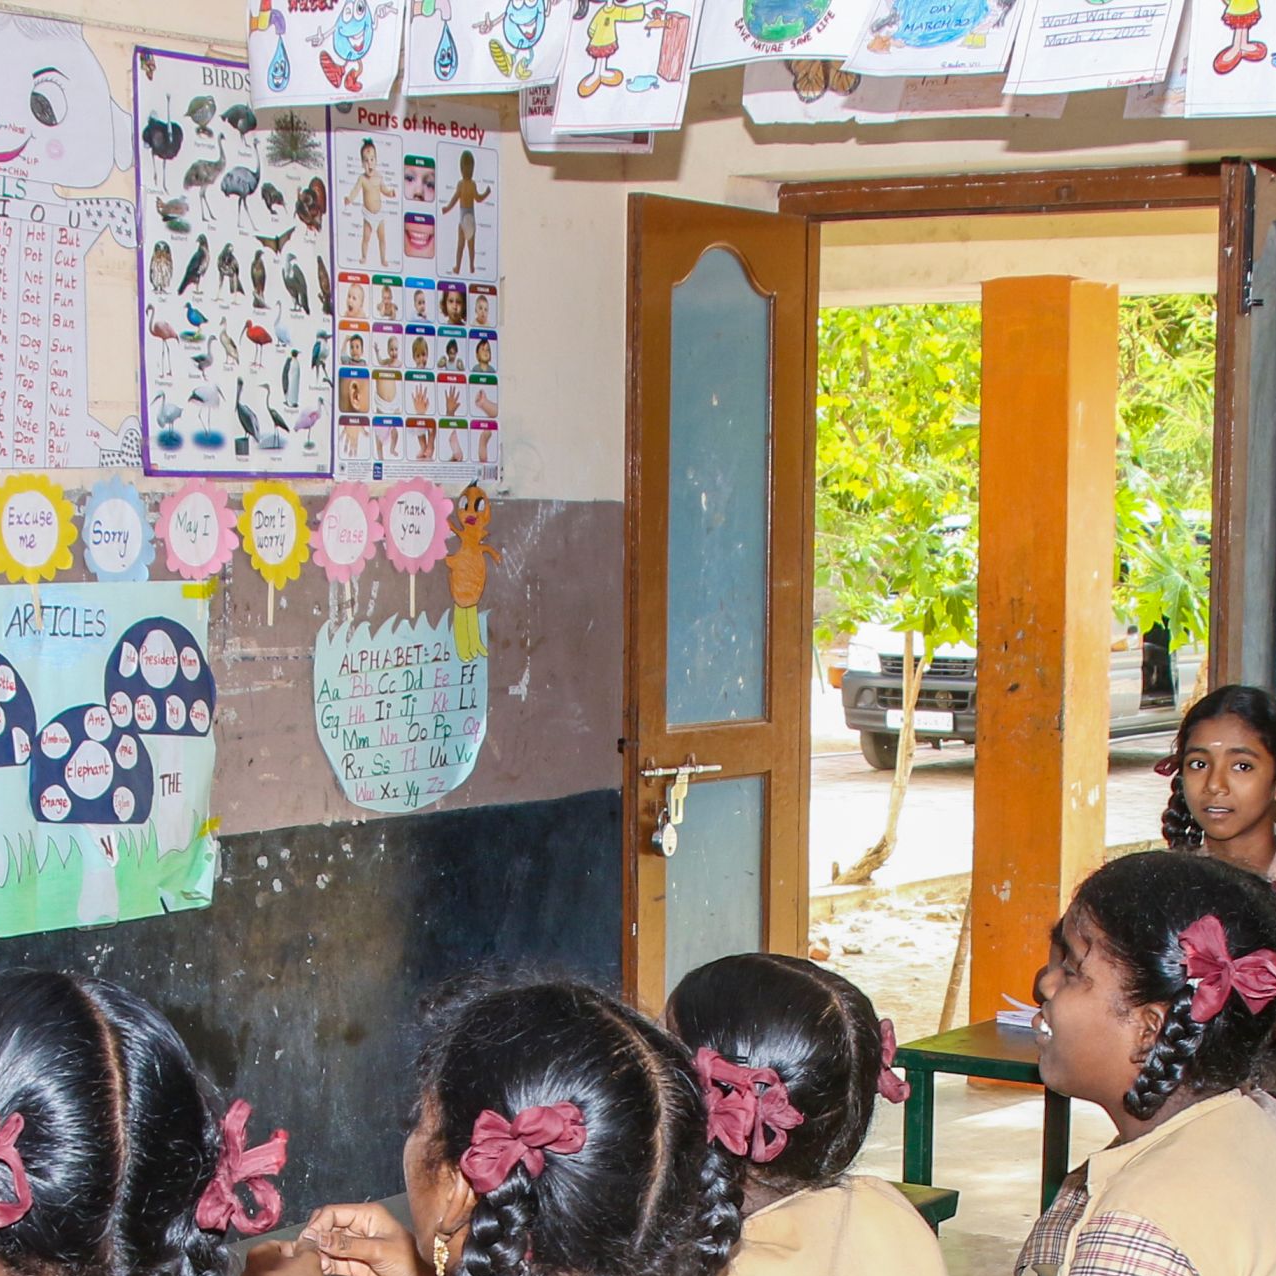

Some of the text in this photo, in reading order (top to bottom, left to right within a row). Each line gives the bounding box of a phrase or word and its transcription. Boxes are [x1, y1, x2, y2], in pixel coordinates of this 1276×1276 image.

[358, 107, 485, 146] Parts of the Body
[30, 204, 45, 222] O
[68, 210, 80, 228] U
[27, 225, 46, 241] Hot
[24, 247, 43, 262] Pot
[54, 250, 77, 268] Cut
[7, 506, 53, 527] Excuse
[254, 509, 286, 529] Don't
[397, 500, 426, 517] Thank
[92, 521, 129, 557] Sorry
[175, 513, 210, 544] May I
[401, 522, 421, 539] you
[19, 532, 37, 549] me
[257, 531, 286, 557] worry
[141, 646, 177, 662] President
[317, 664, 478, 703] Aa Bb Cc Dd Ee Ff
[87, 713, 105, 727] Ant
[321, 688, 477, 739] Gg Hh Ii Jj Kk Ll
[160, 772, 182, 796] THE
